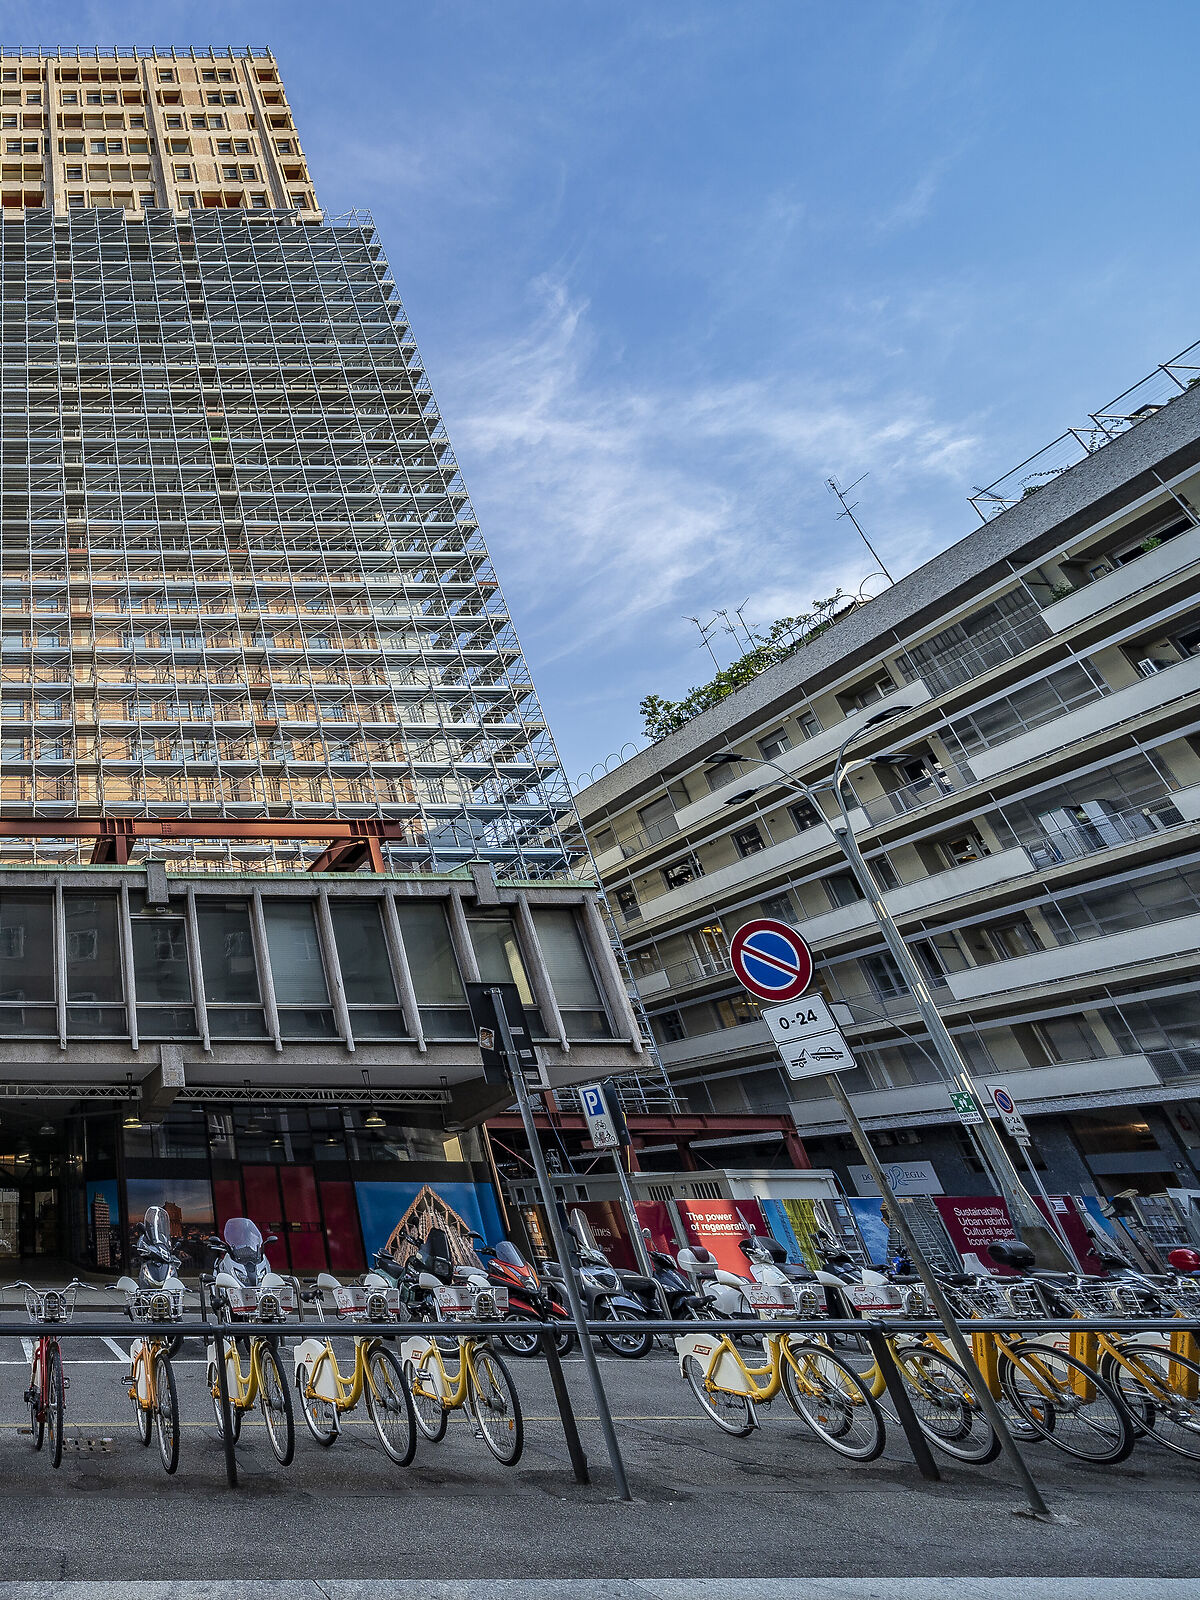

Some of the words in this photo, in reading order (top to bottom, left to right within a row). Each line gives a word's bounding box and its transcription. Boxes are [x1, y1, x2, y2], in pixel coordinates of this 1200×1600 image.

[778, 1009, 818, 1030] 0-24
[1004, 1116, 1022, 1124] 0-24
[861, 1172, 891, 1181] DOS
[686, 1212, 704, 1221] The
[705, 1213, 733, 1222] power
[953, 1207, 1004, 1217] Sustainability
[958, 1217, 983, 1226] Urban
[983, 1216, 1010, 1226] rebirth
[690, 1222, 700, 1231] of
[701, 1222, 757, 1232] regeneratin
[962, 1226, 994, 1236] Cultural
[993, 1226, 1015, 1237] legac
